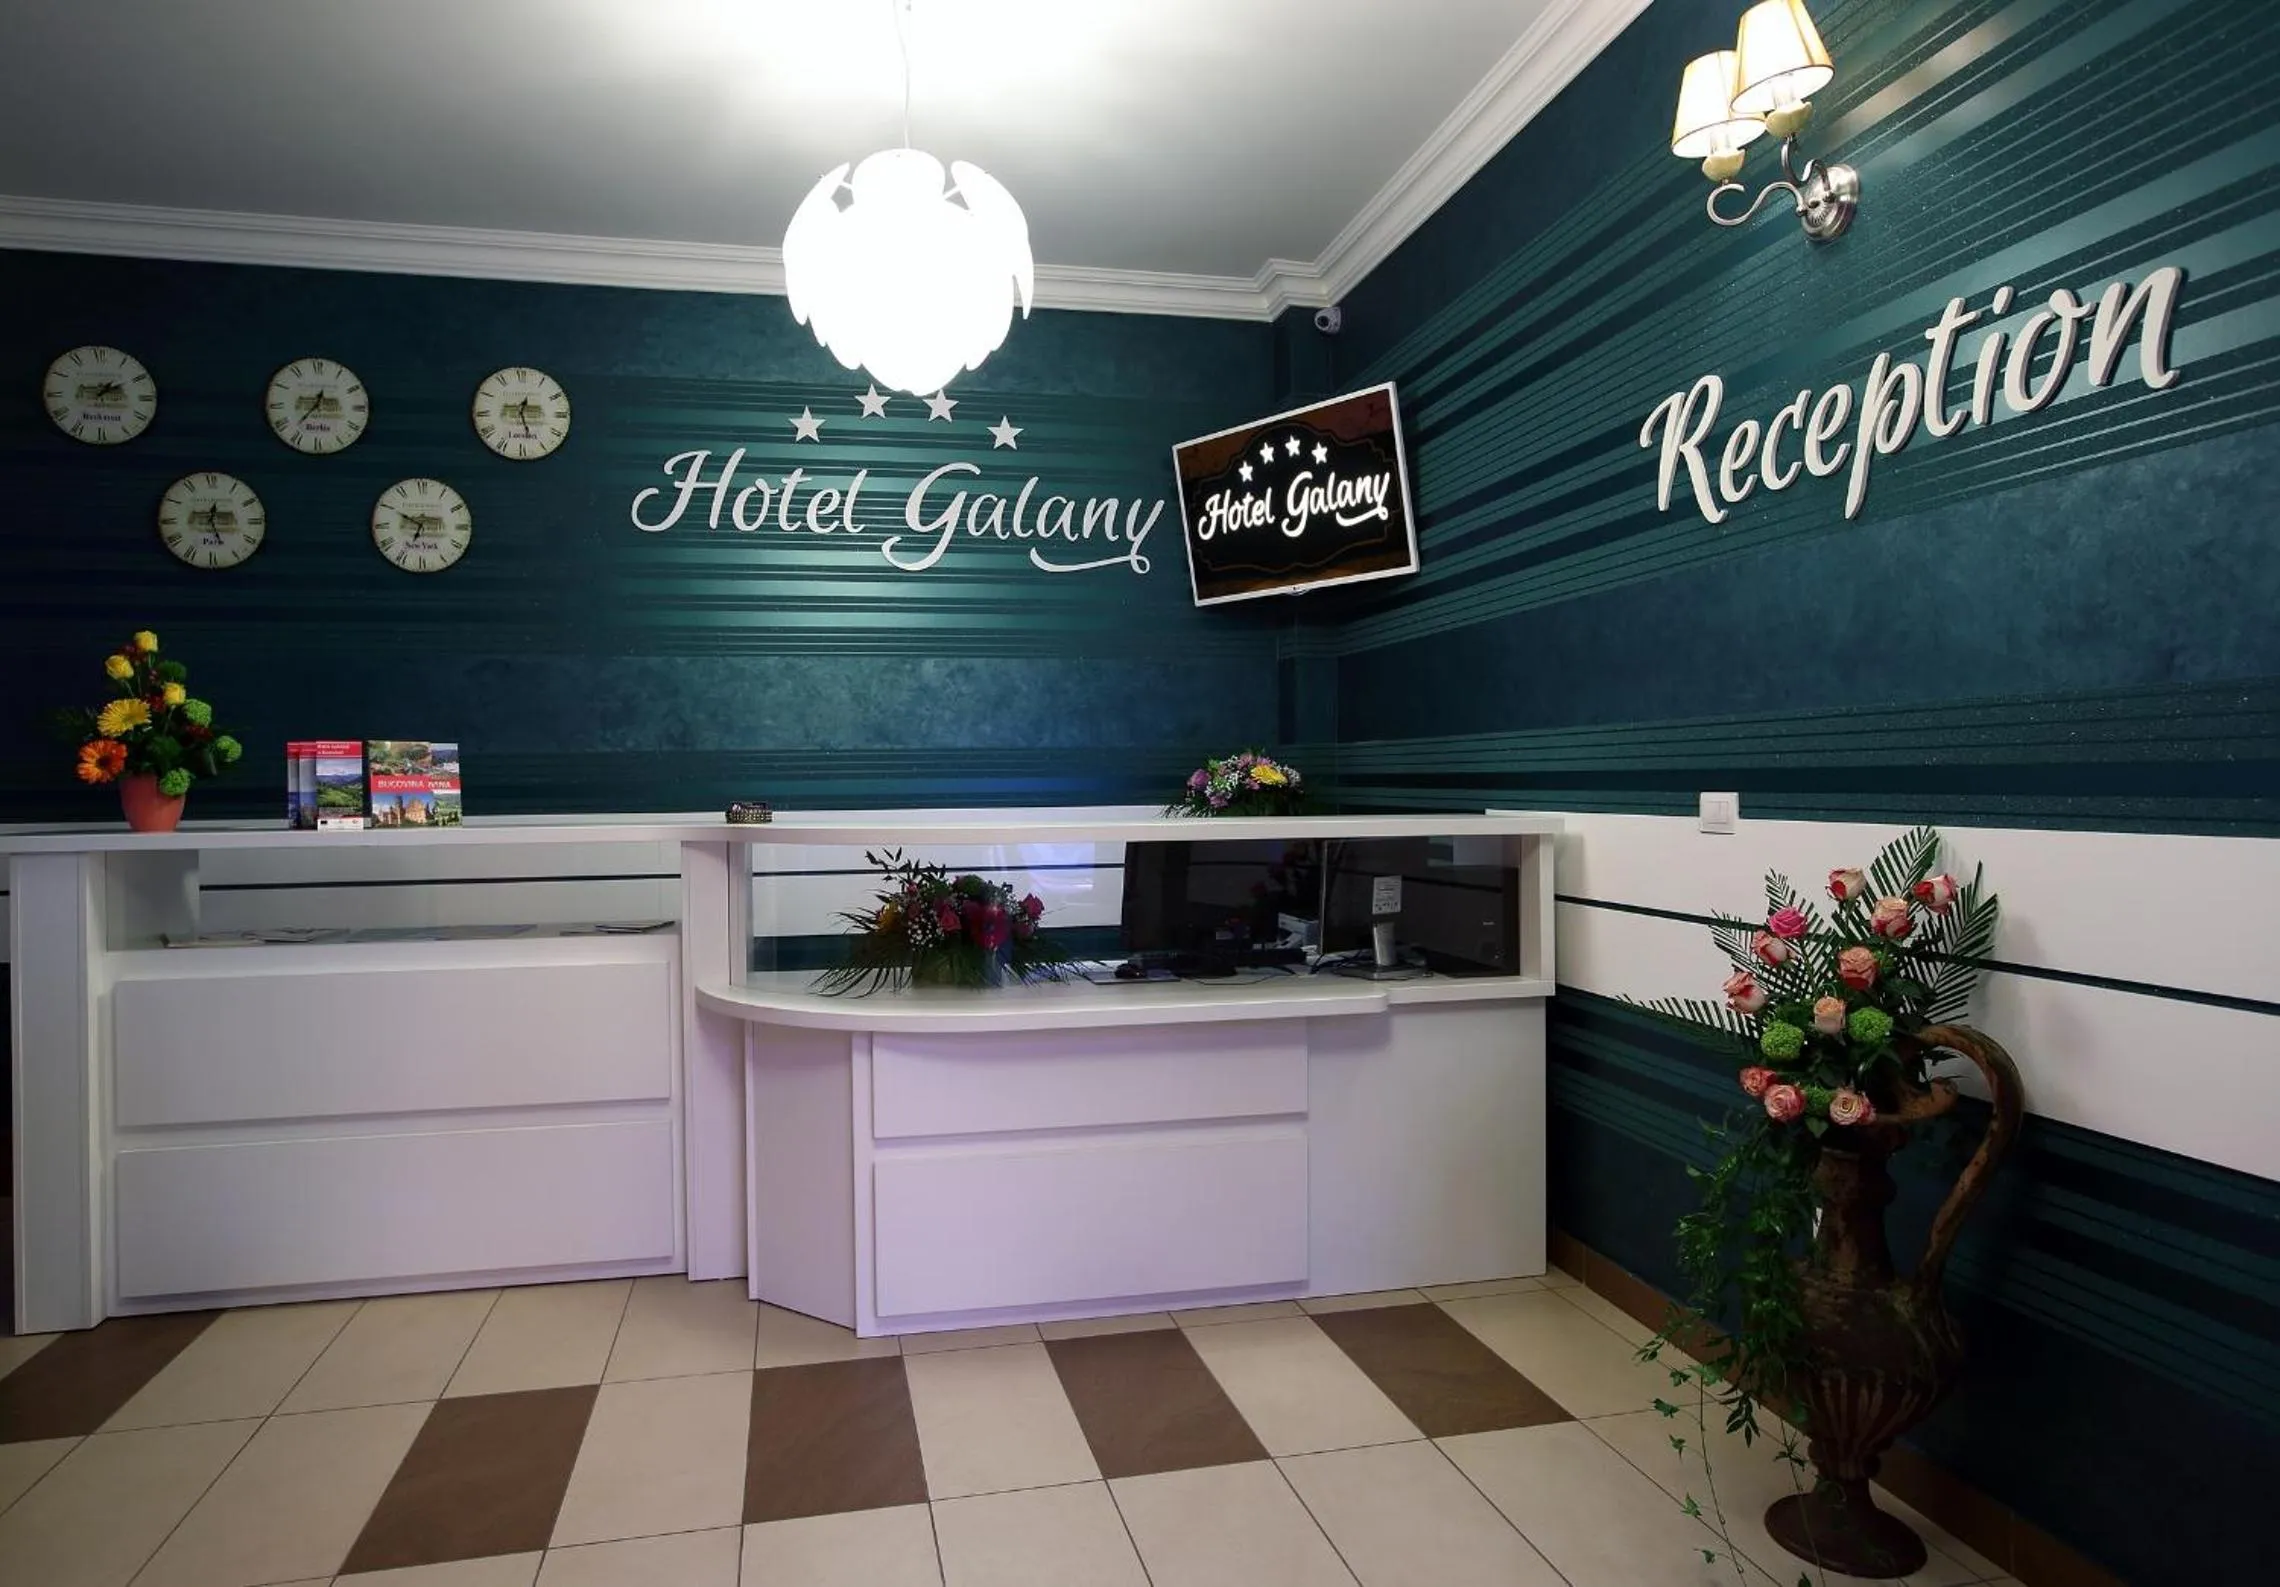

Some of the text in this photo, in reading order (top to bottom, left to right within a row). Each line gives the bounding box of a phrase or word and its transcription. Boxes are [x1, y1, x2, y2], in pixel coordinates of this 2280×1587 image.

[1639, 265, 2188, 525] Reception
[305, 423, 331, 432] Berlin
[630, 446, 1165, 575] Hotel Galany
[1197, 470, 1391, 541] Hotel Galany
[405, 541, 439, 550] New York
[378, 780, 425, 789] BUCOVINA
